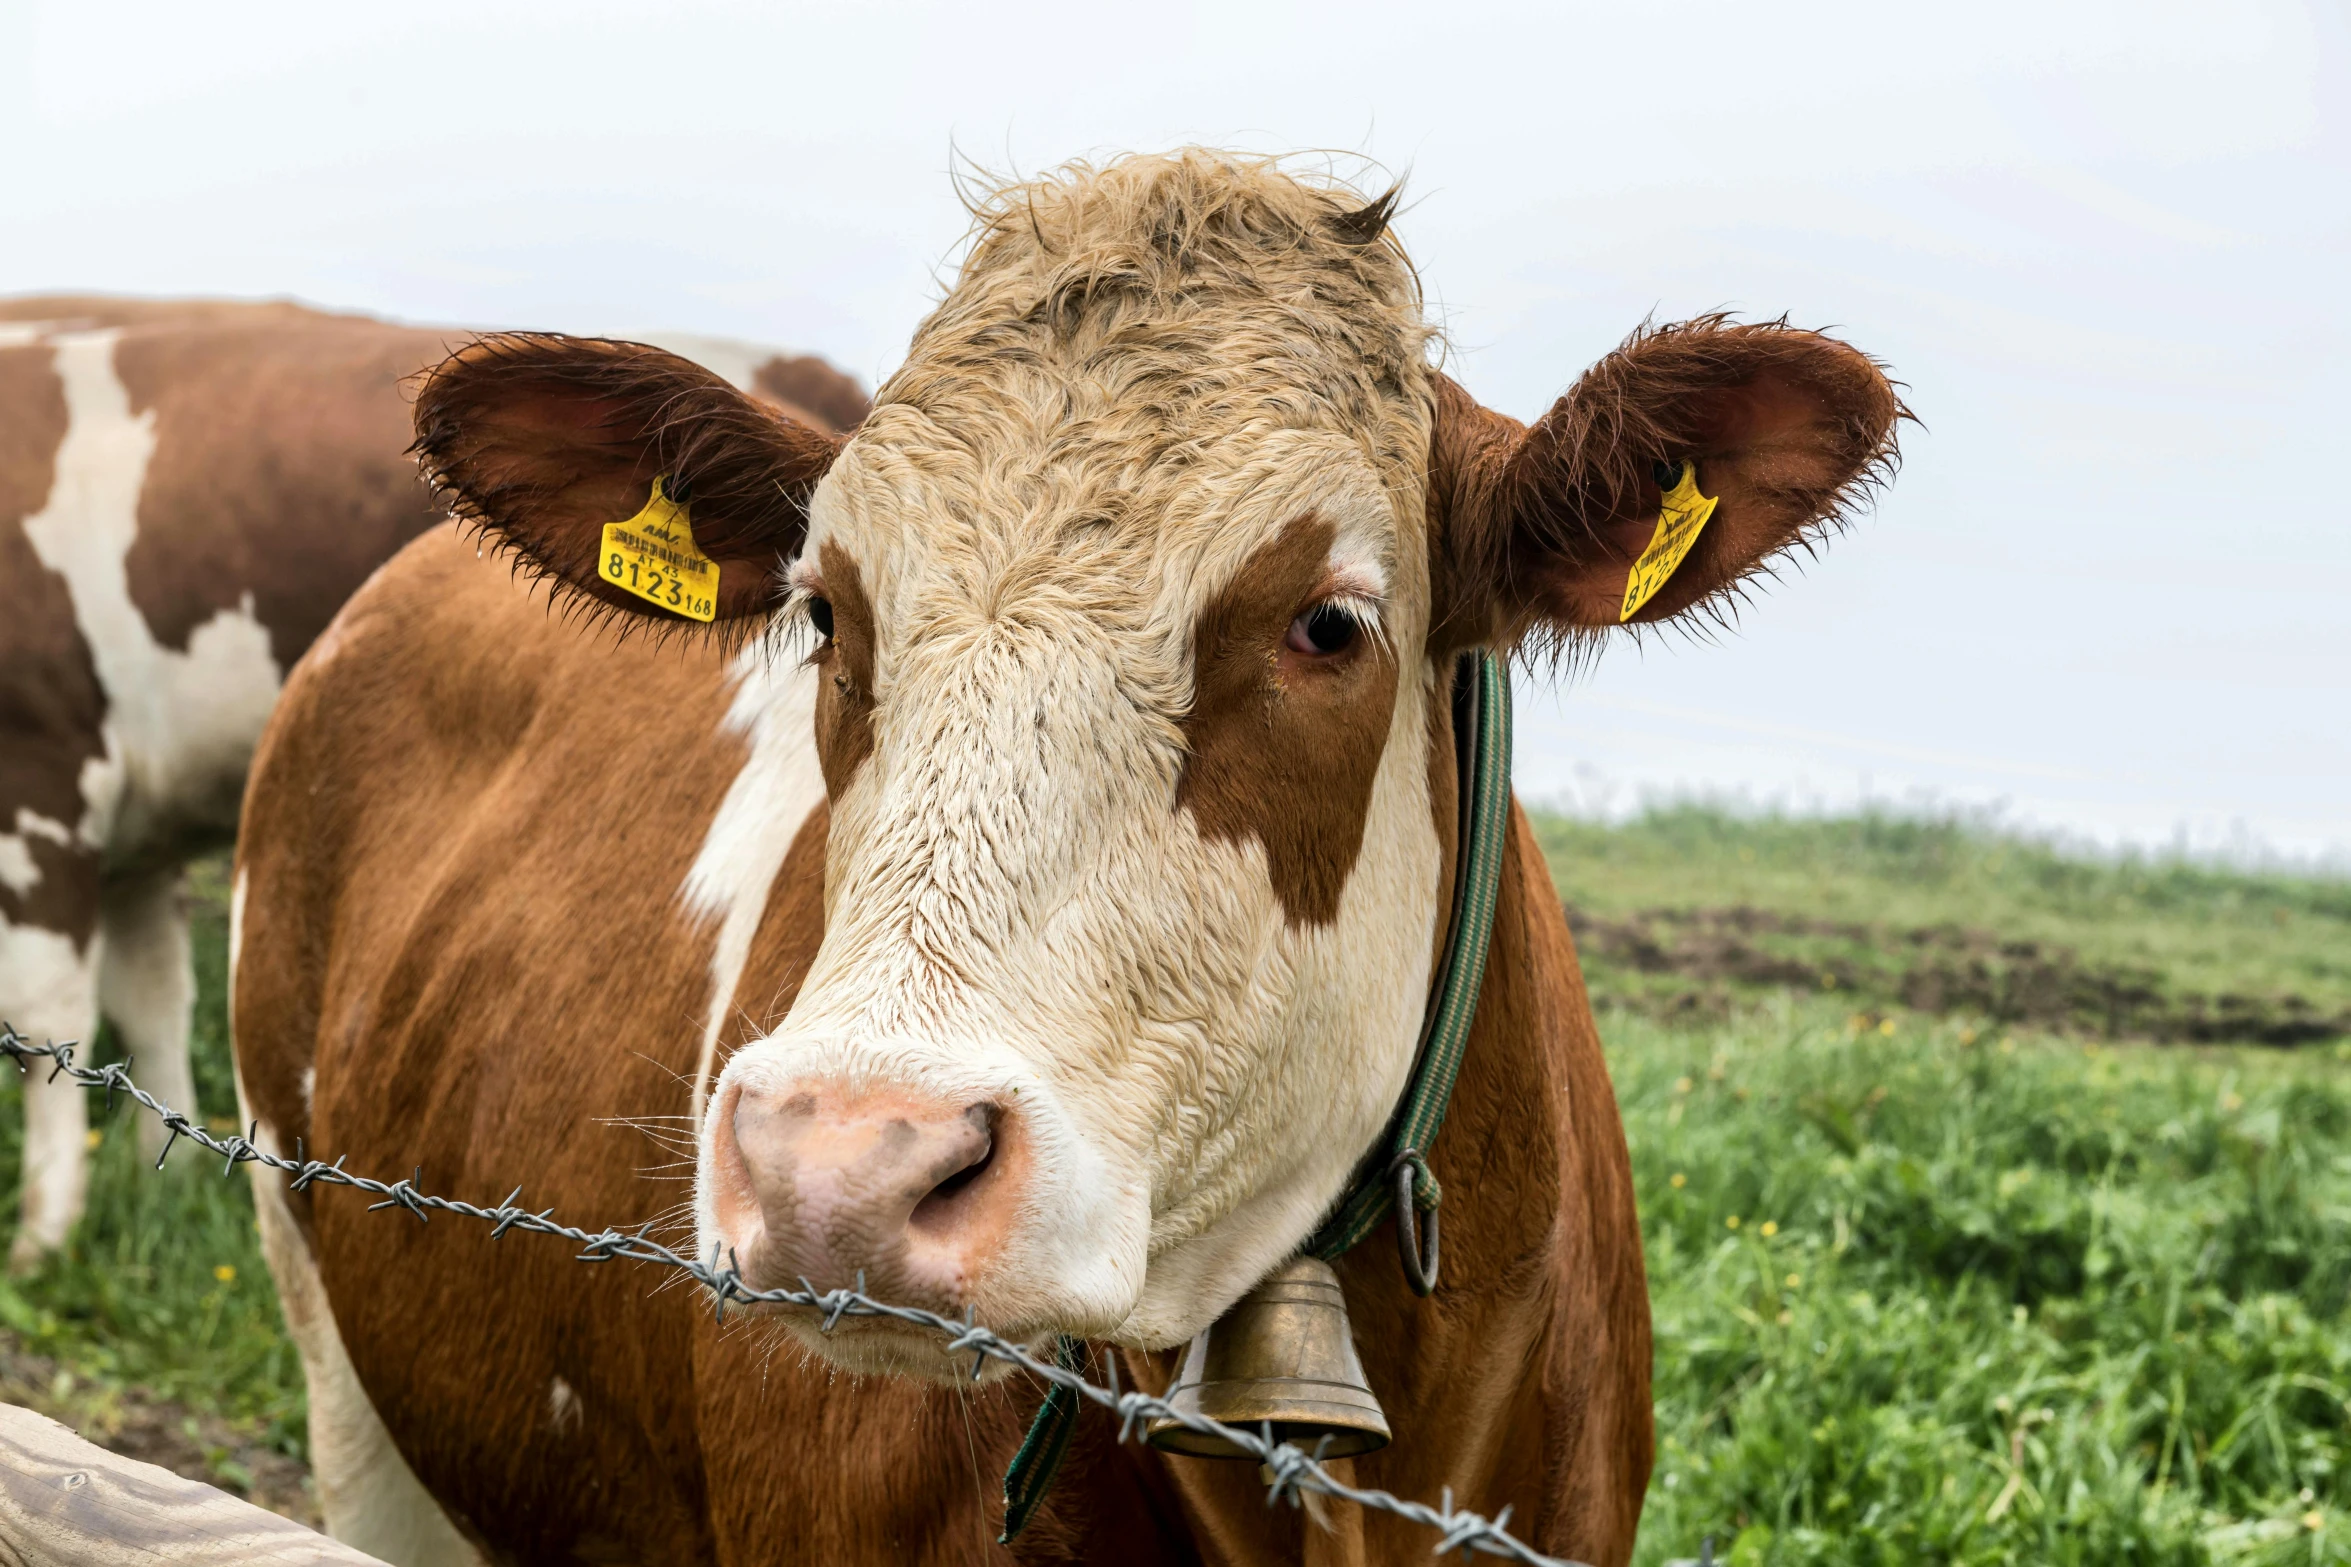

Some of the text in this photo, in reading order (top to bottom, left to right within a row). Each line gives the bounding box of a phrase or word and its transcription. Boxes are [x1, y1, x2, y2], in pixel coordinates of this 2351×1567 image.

[608, 553, 711, 616] 8123 168
[638, 554, 679, 578] AT 43
